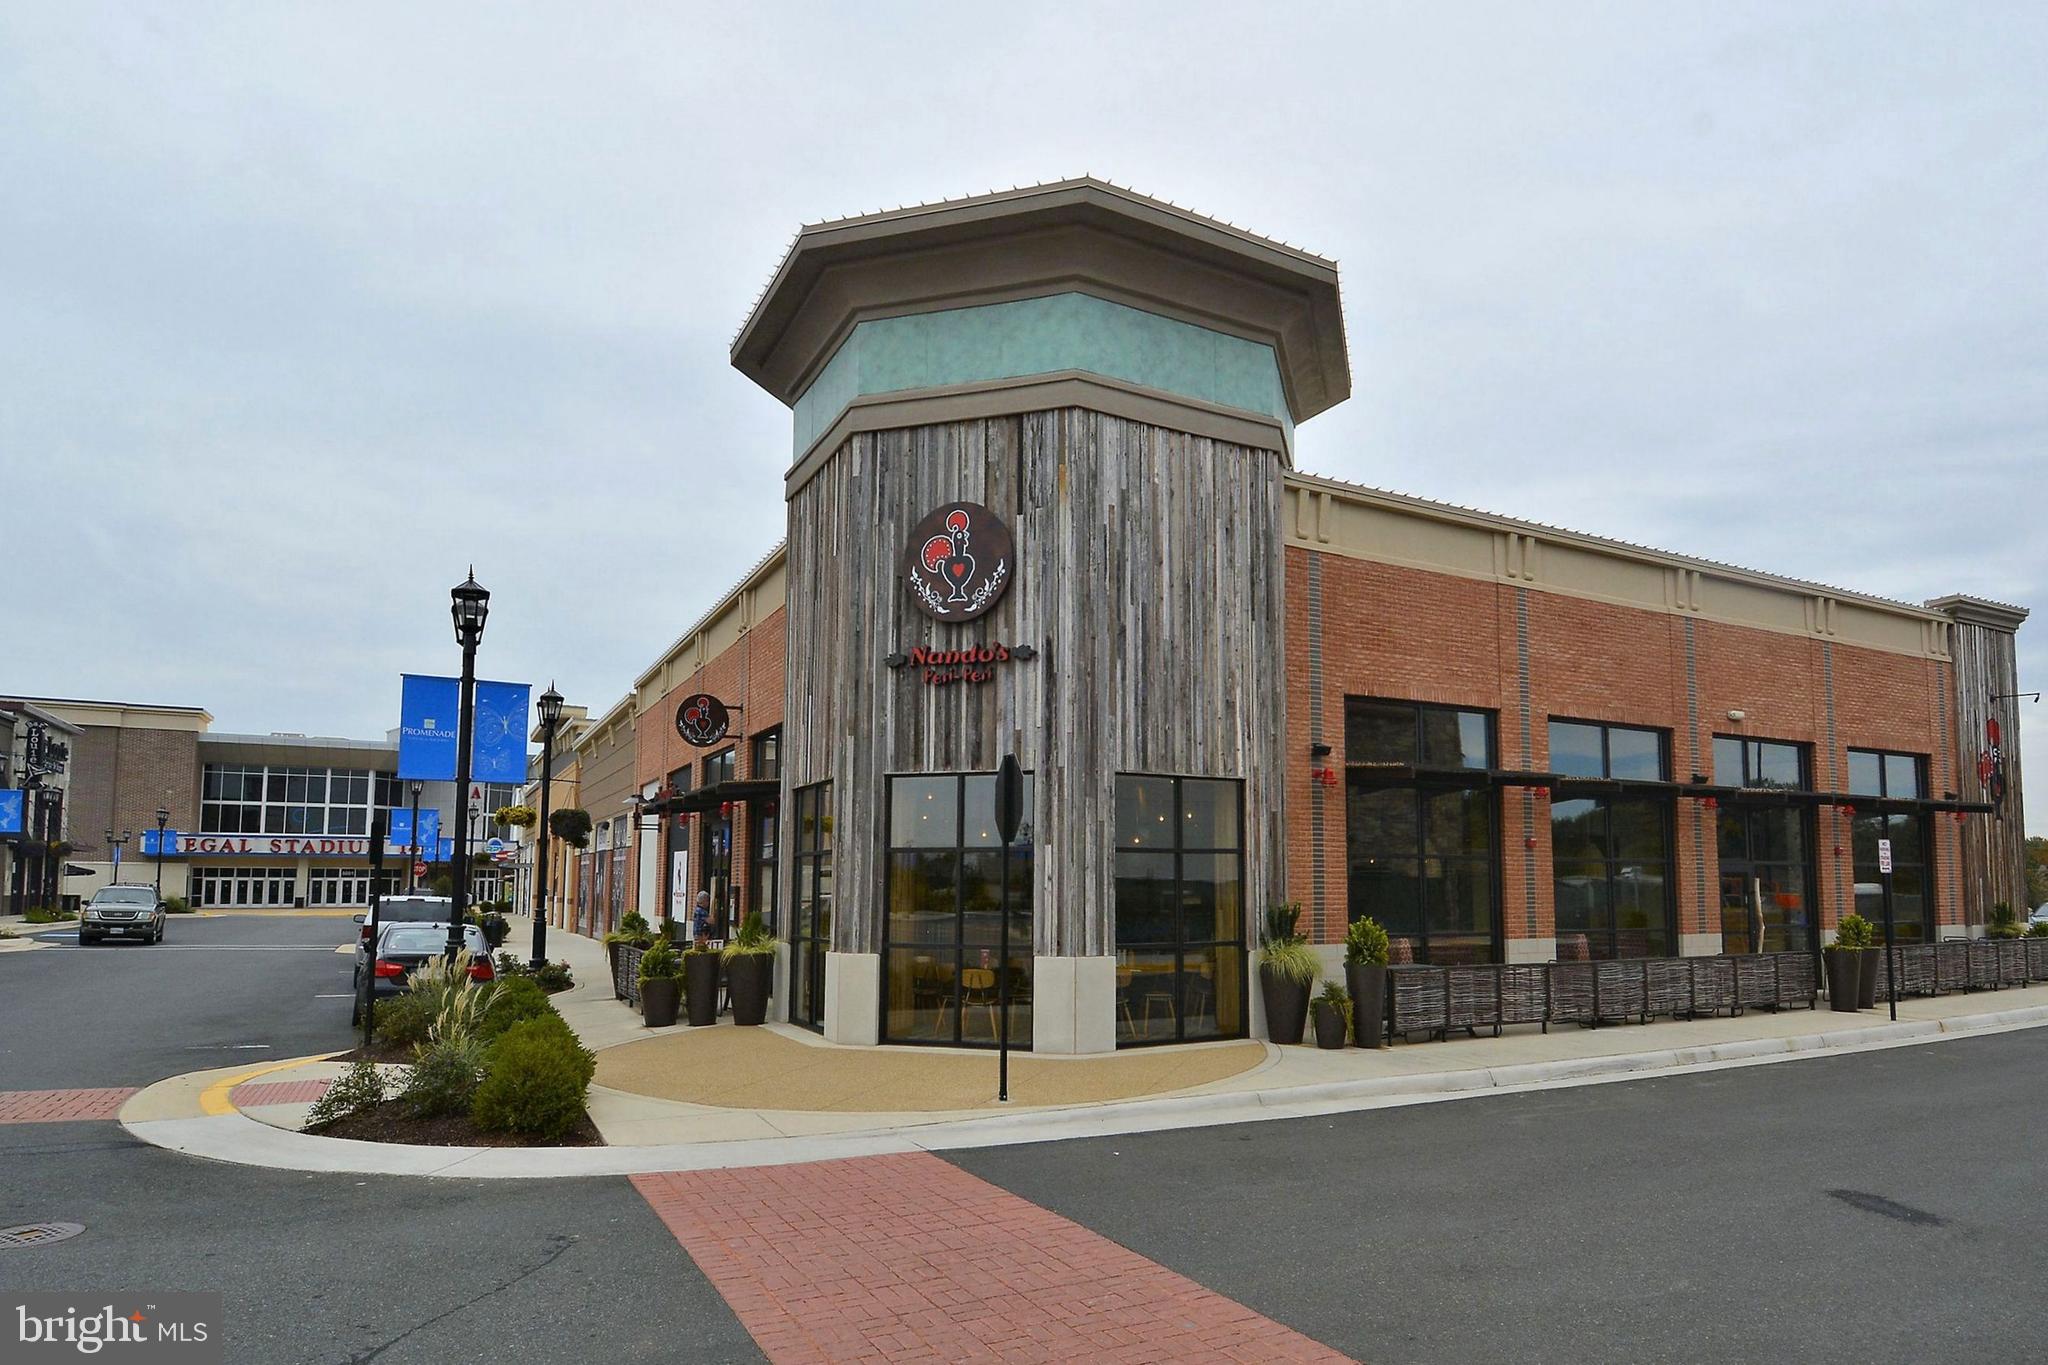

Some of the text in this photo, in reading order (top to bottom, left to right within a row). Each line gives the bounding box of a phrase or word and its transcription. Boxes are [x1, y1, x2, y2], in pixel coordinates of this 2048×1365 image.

[910, 640, 1009, 668] Nando's
[402, 726, 456, 739] PROMENADE
[175, 837, 253, 853] EGAL
[269, 838, 372, 854] STADIU
